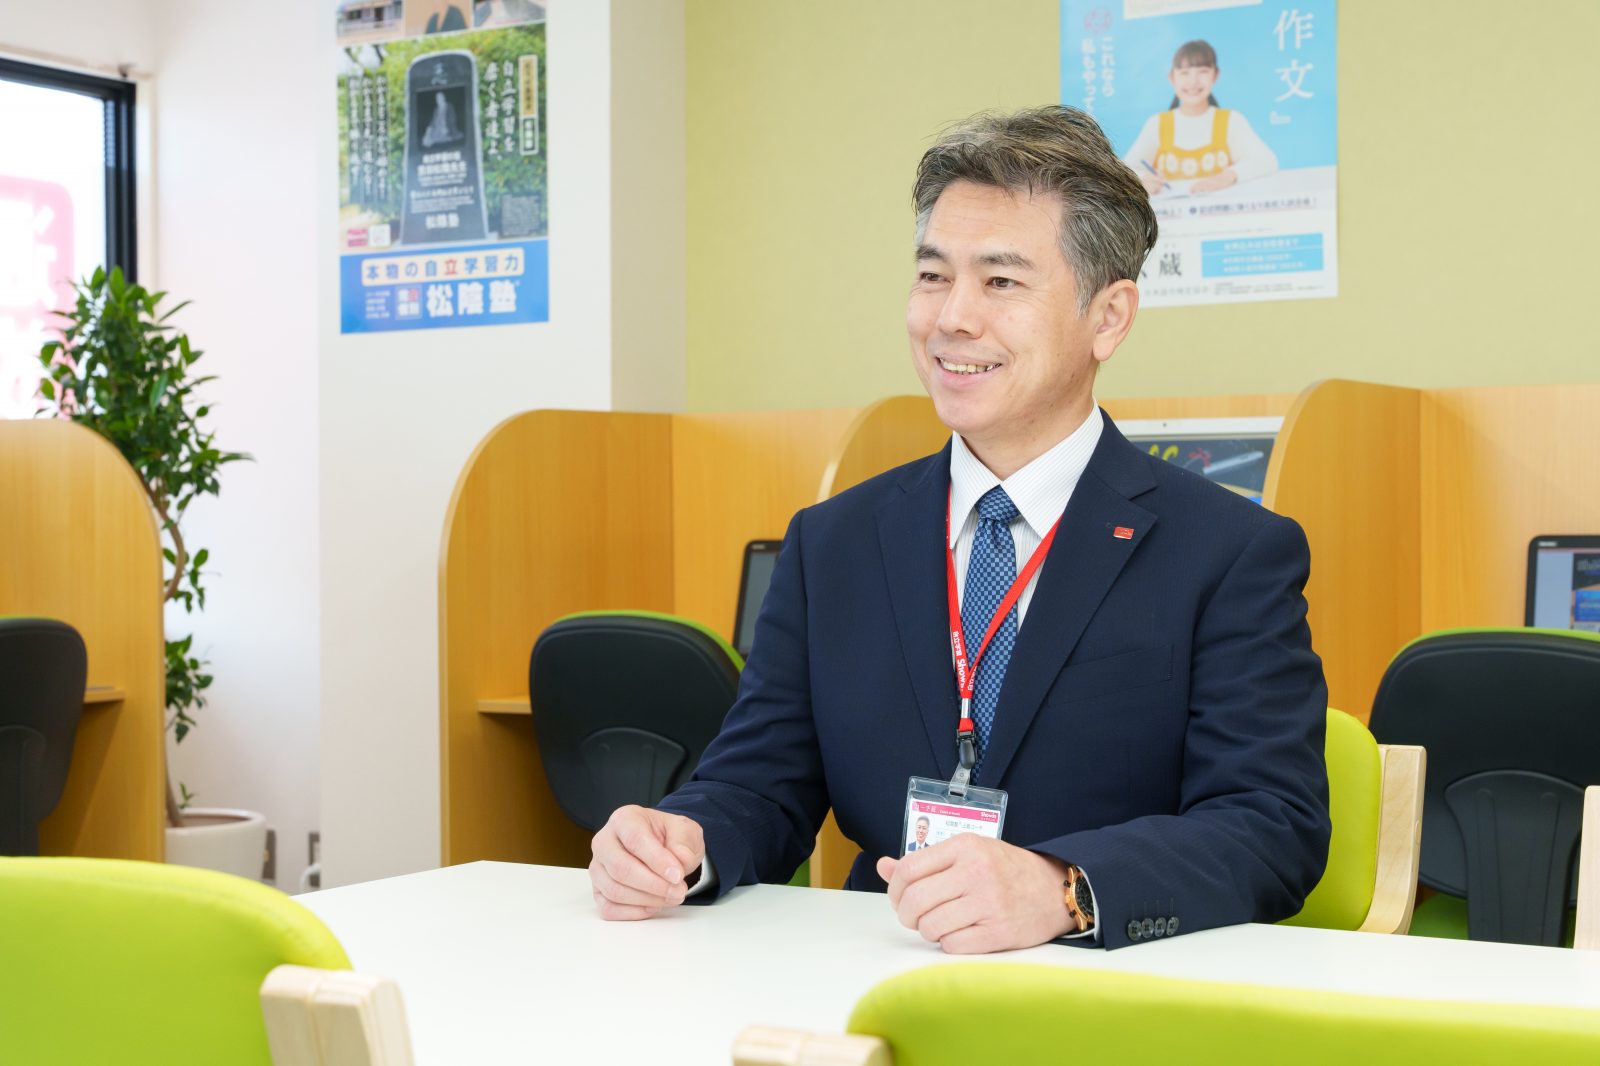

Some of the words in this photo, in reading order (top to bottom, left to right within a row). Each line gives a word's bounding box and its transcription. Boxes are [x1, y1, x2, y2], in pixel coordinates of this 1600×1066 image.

[1101, 36, 1115, 98] これなら
[367, 254, 519, 280] 本物の自立学習力
[427, 279, 517, 318] 松陰塾
